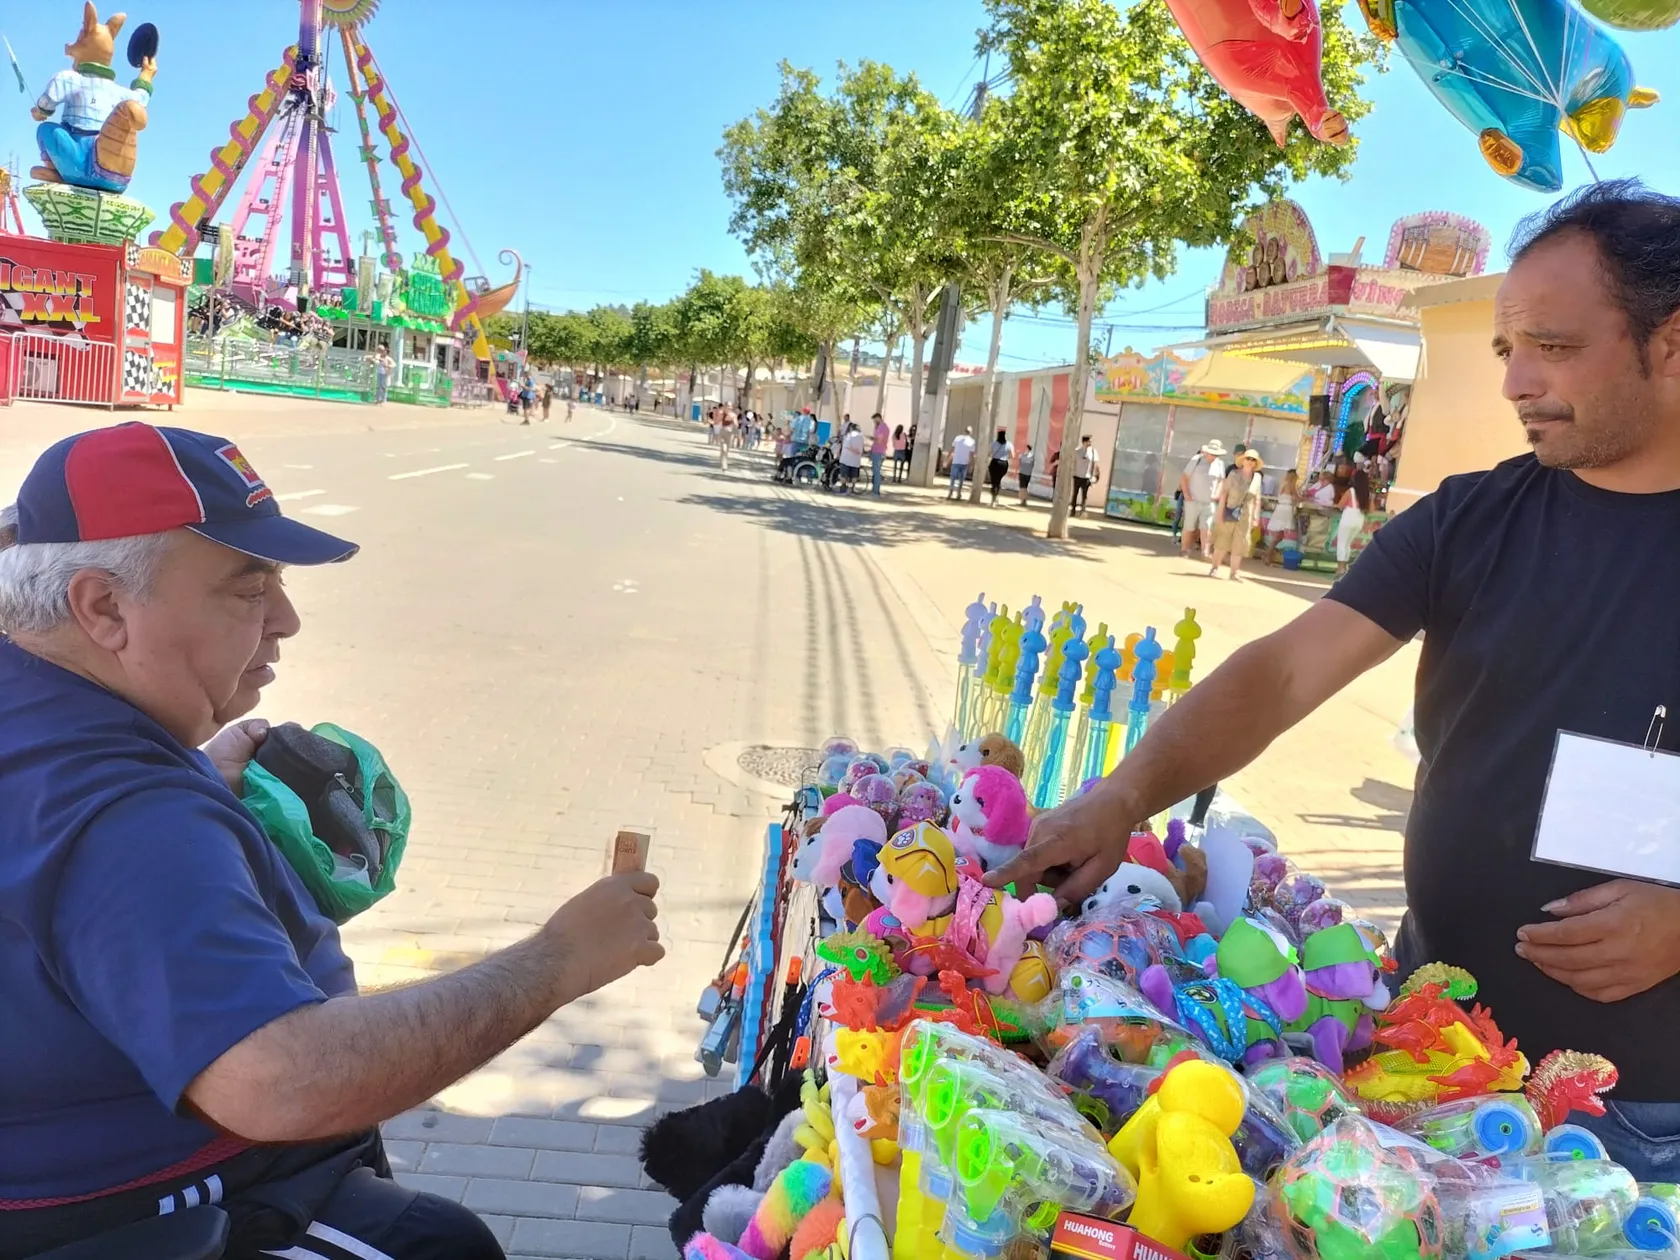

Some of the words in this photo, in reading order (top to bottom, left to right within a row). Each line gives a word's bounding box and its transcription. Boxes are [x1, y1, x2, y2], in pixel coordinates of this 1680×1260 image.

[0, 263, 97, 297] IGANT
[20, 292, 101, 323] XXL
[1063, 1220, 1114, 1243] HUAHONG
[1098, 1240, 1116, 1251] Battery
